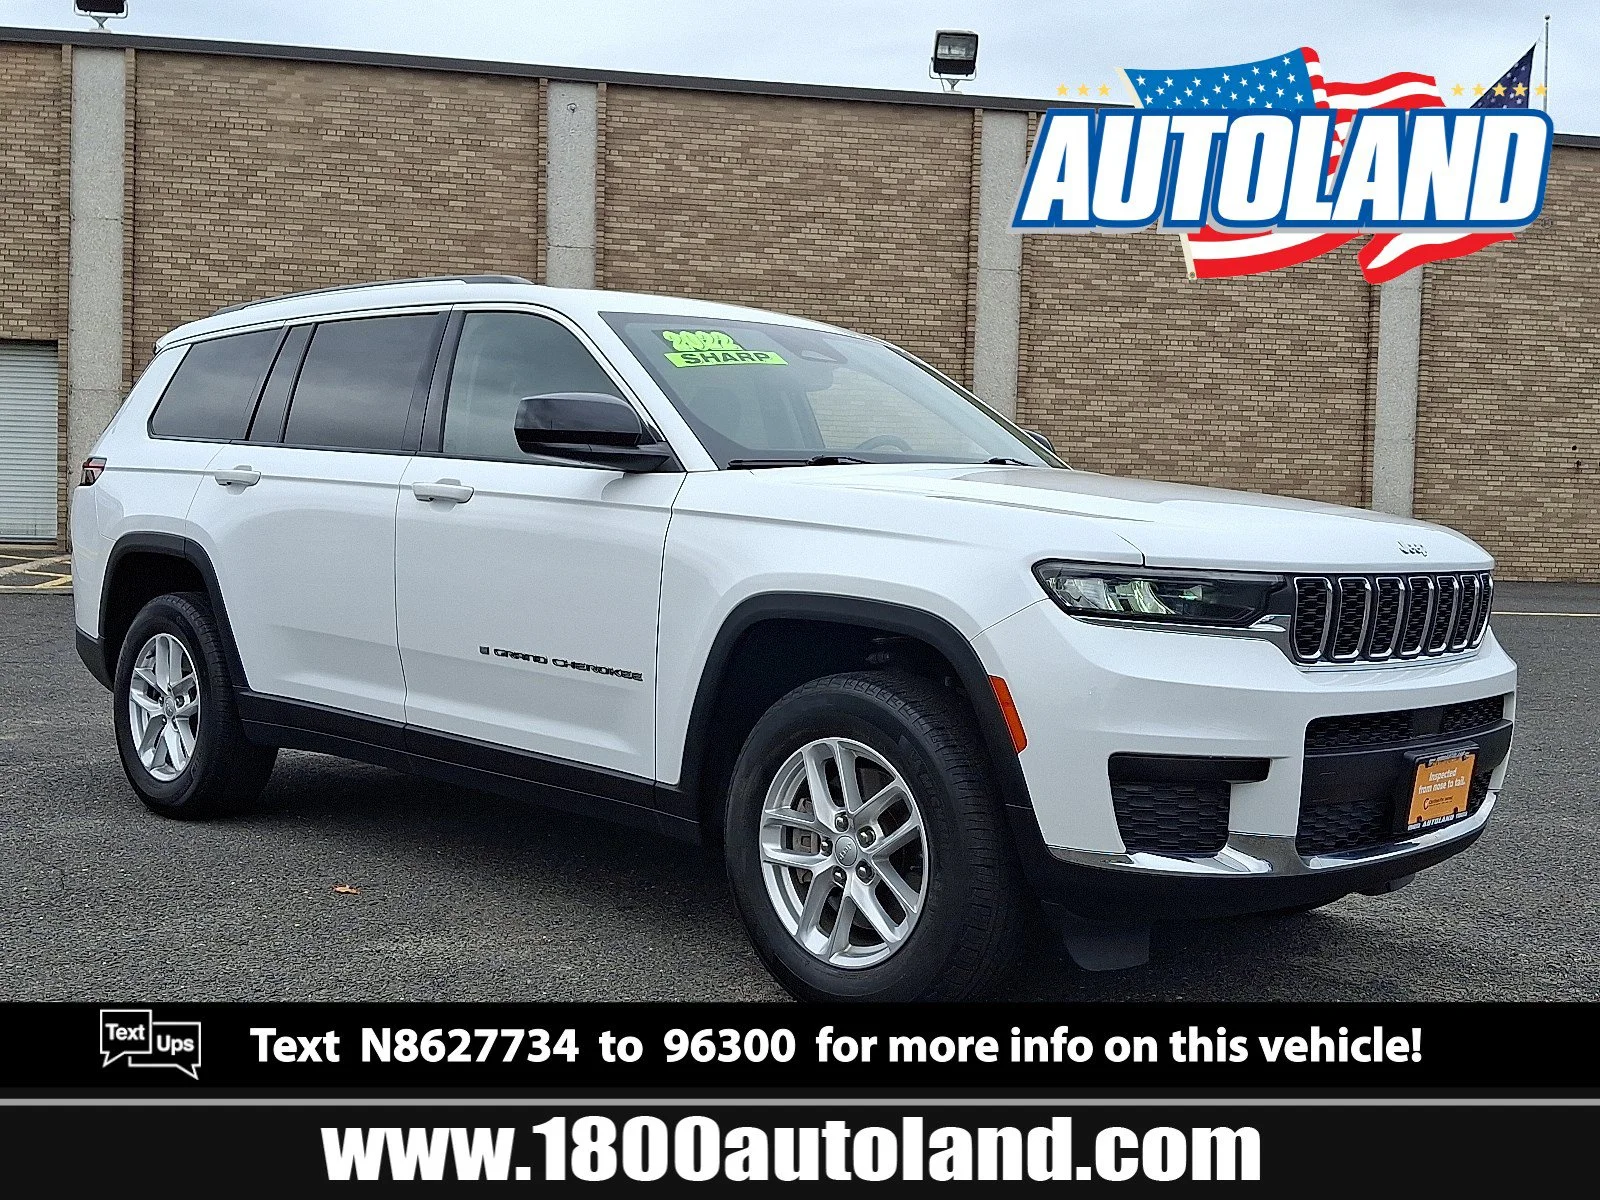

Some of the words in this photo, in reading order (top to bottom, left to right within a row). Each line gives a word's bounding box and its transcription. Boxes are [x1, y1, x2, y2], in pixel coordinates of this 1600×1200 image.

[662, 330, 744, 351] 2022
[680, 352, 772, 365] SHARP
[1396, 541, 1428, 558] Jeep
[493, 648, 549, 665] GRAND
[551, 658, 644, 682] CHEROKEE
[1428, 767, 1458, 782] Inspected
[1418, 784, 1433, 795] from
[1432, 781, 1447, 792] nose
[1447, 780, 1454, 789] to
[1421, 814, 1455, 828] AUTOLAND
